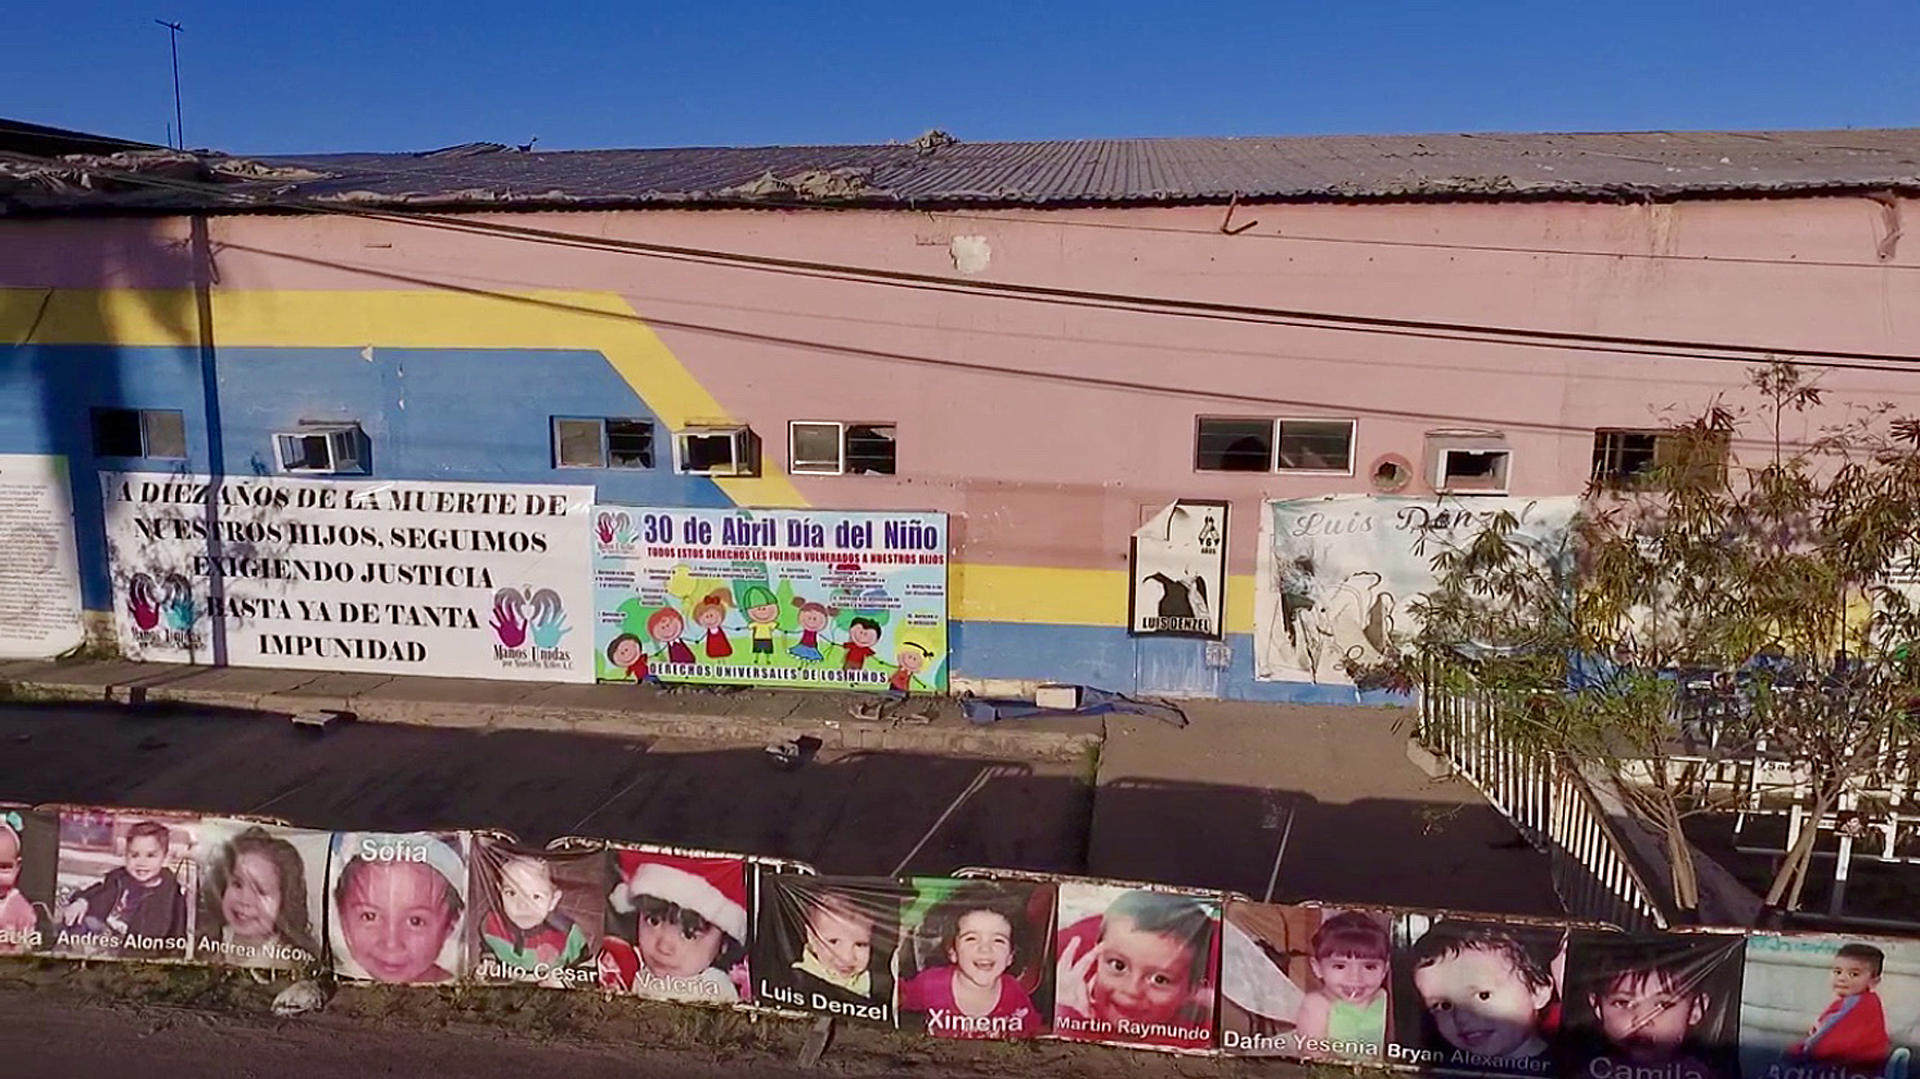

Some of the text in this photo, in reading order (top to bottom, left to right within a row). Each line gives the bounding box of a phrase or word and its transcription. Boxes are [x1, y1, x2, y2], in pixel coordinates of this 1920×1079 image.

[118, 481, 567, 516] A DIEZ AÑOS DE LA MUERTE DE
[1292, 500, 1536, 538] Luis Denzl
[134, 517, 548, 553] NUESTROS HIJOS, SEGUIMOS
[644, 514, 938, 550] 30 de Abril Día del Niño
[648, 546, 675, 558] TODOS
[677, 547, 704, 559] ESTOS
[706, 548, 750, 561] DERECHOS
[752, 551, 767, 562] LES
[769, 552, 801, 563] FUERON
[803, 552, 860, 564] VULNERADOS
[862, 554, 869, 564] A
[870, 554, 916, 565] NUESTROS
[919, 555, 944, 566] HIJOS
[193, 556, 494, 589] EXIGIENDO JUSTICIA
[206, 596, 480, 629] BASTA YA DE TANTA
[1142, 616, 1209, 632] LUIS DENZEL
[258, 634, 427, 662] IMPUNIDAD
[493, 644, 571, 662] Manos Unidas
[650, 663, 712, 677] DERECHOS
[716, 665, 797, 681] UNIVERSALES
[802, 669, 816, 681] DE
[821, 670, 843, 682] LOS
[361, 839, 428, 863] Sofia
[0, 926, 43, 946] aula
[123, 933, 187, 951] Alonso
[198, 936, 256, 958] Andrea
[476, 957, 527, 979] Julio
[635, 970, 721, 997] Valeria
[761, 979, 888, 1022] Luis Denzel
[926, 1009, 1024, 1033] Ximena
[1117, 1019, 1210, 1041] Raymundo
[1224, 1031, 1378, 1057] Dafne Yesenia
[1387, 1043, 1551, 1072] Bryan Alexander
